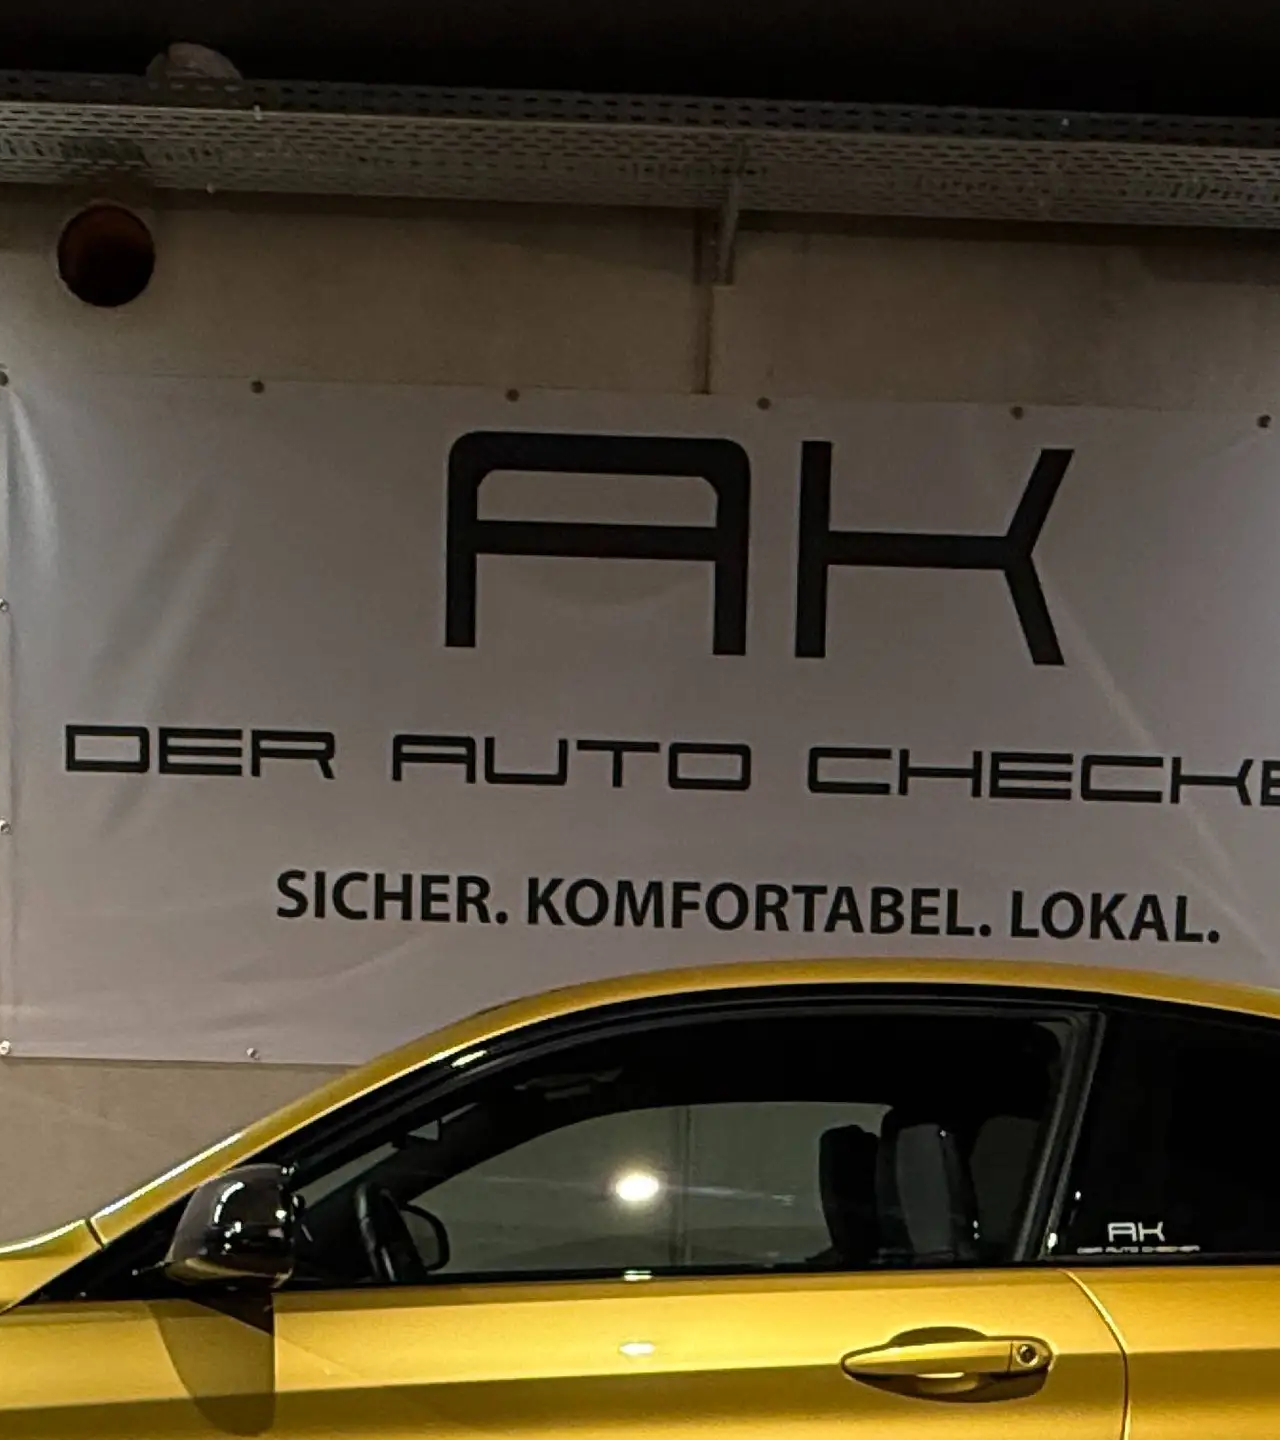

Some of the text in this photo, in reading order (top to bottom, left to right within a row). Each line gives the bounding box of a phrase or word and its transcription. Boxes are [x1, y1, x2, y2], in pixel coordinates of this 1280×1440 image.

[444, 431, 1075, 666] AK
[65, 724, 336, 780] DER
[391, 733, 752, 792] AUTO
[276, 869, 1220, 944] SICHER. KOMFORTABEL. LOKAL.
[1107, 1221, 1166, 1242] AK
